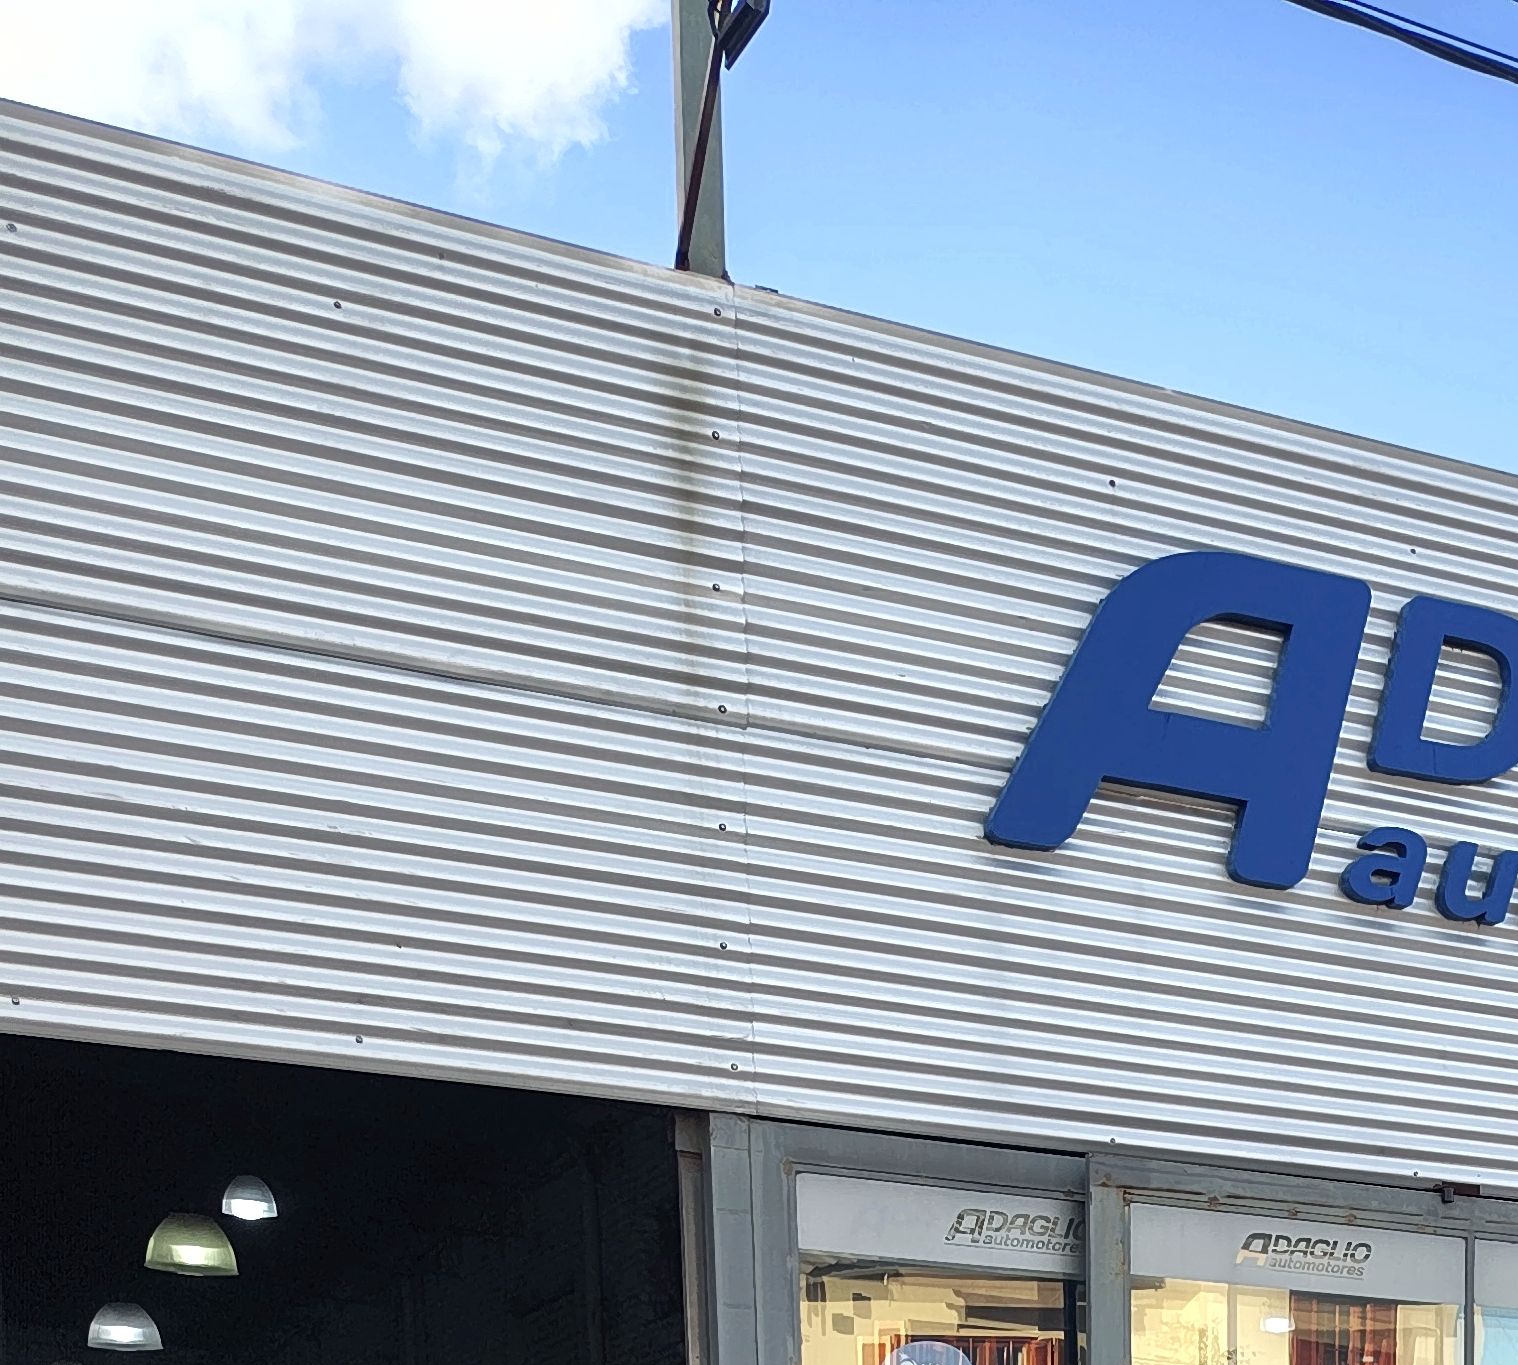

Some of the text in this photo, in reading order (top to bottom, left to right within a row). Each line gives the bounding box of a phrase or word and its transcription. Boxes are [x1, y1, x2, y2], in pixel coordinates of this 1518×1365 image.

[983, 1234, 1081, 1253] automotore
[1235, 1232, 1372, 1266] ADAGLIO
[1269, 1256, 1365, 1277] automotores
